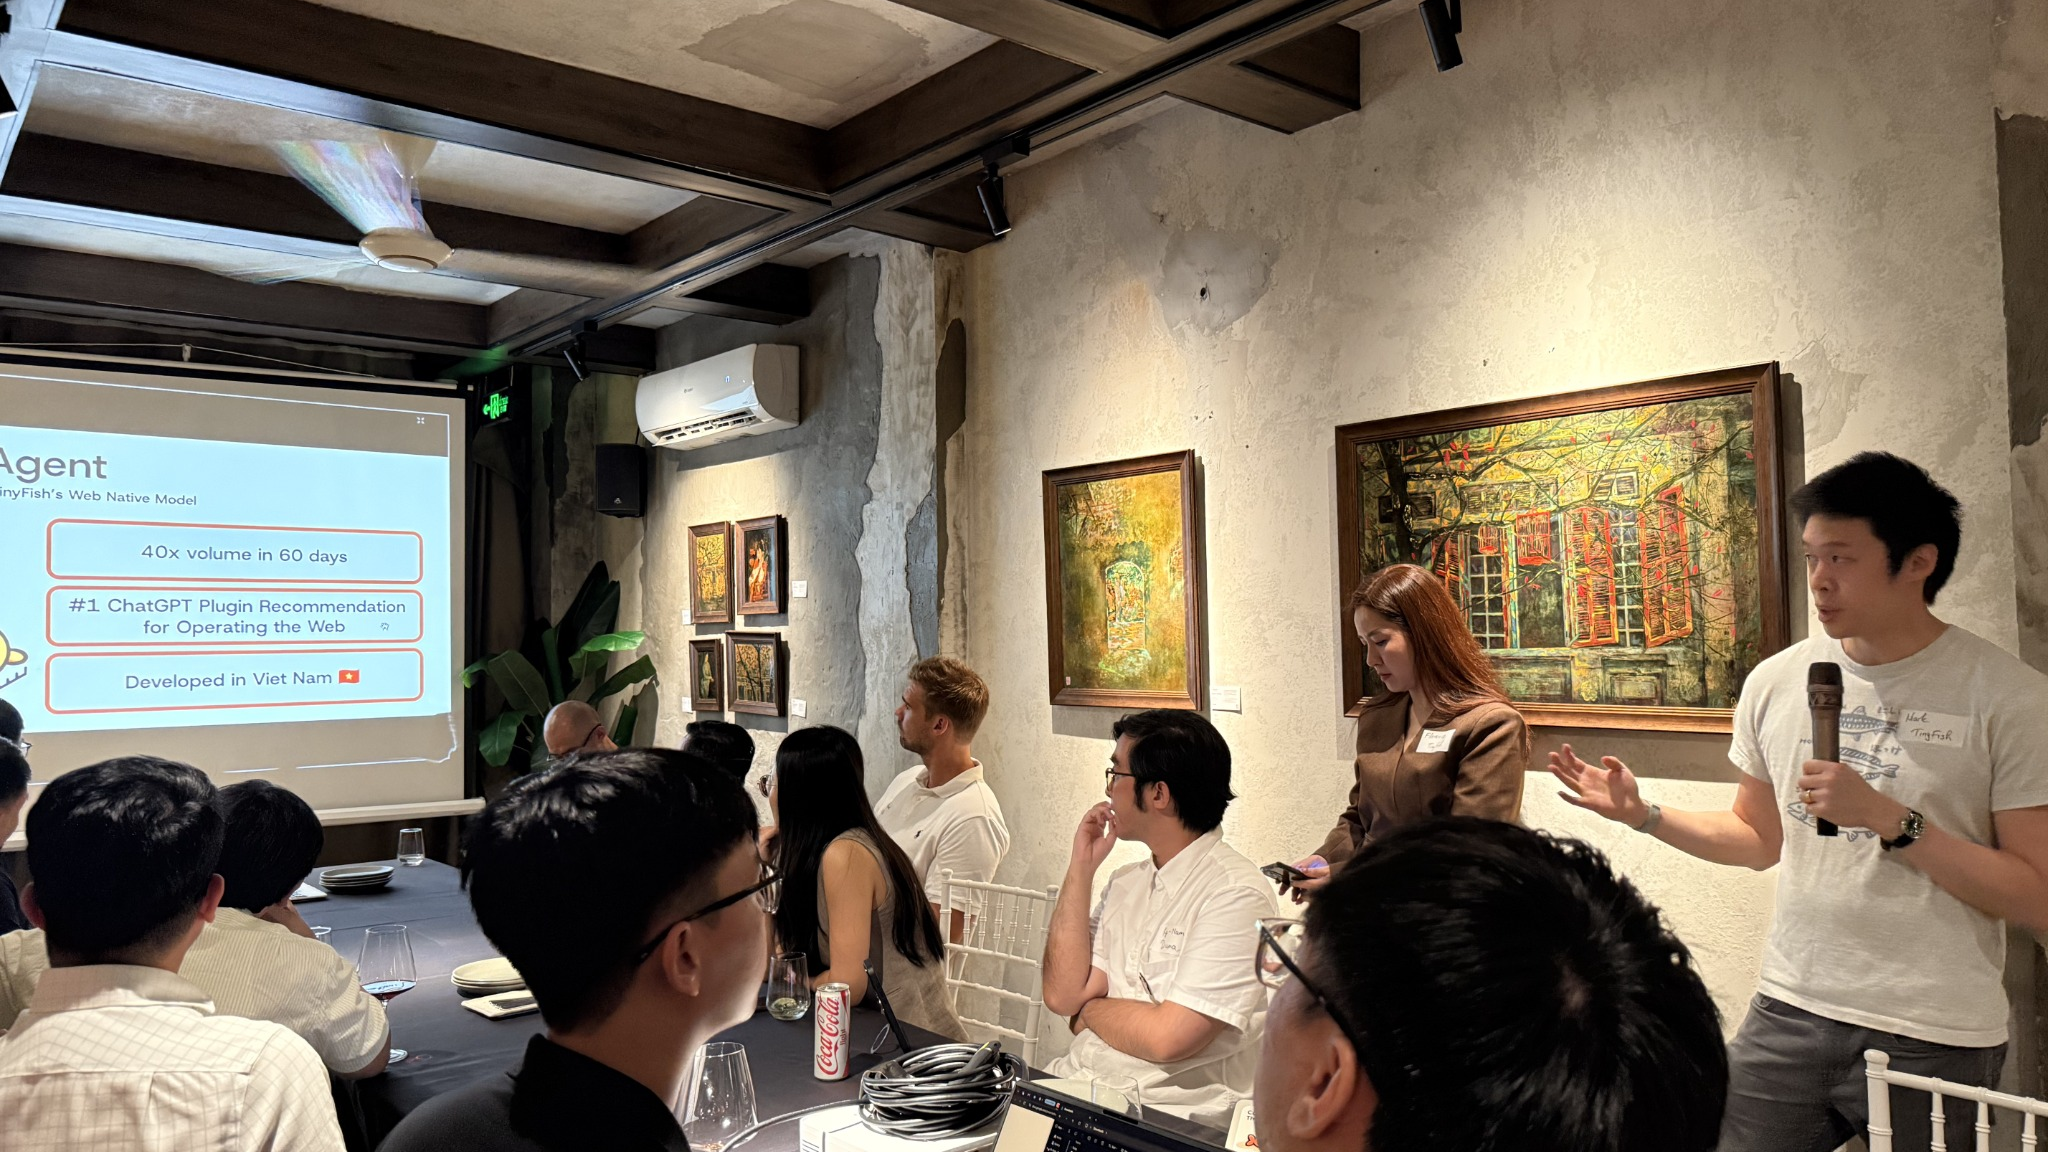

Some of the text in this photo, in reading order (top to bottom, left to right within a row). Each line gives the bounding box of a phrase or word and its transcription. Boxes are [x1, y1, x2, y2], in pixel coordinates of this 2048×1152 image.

[0, 447, 107, 484] Agent
[0, 487, 197, 505] inyFish's Web Native Model
[141, 545, 348, 565] 40x volume in 60 days
[68, 598, 406, 616] #1 ChatGPT Plugin Recommendation
[143, 620, 346, 637] for Operating the Web
[125, 672, 332, 691] Developed in Viet Nam
[816, 995, 839, 1075] Coca-Cola
